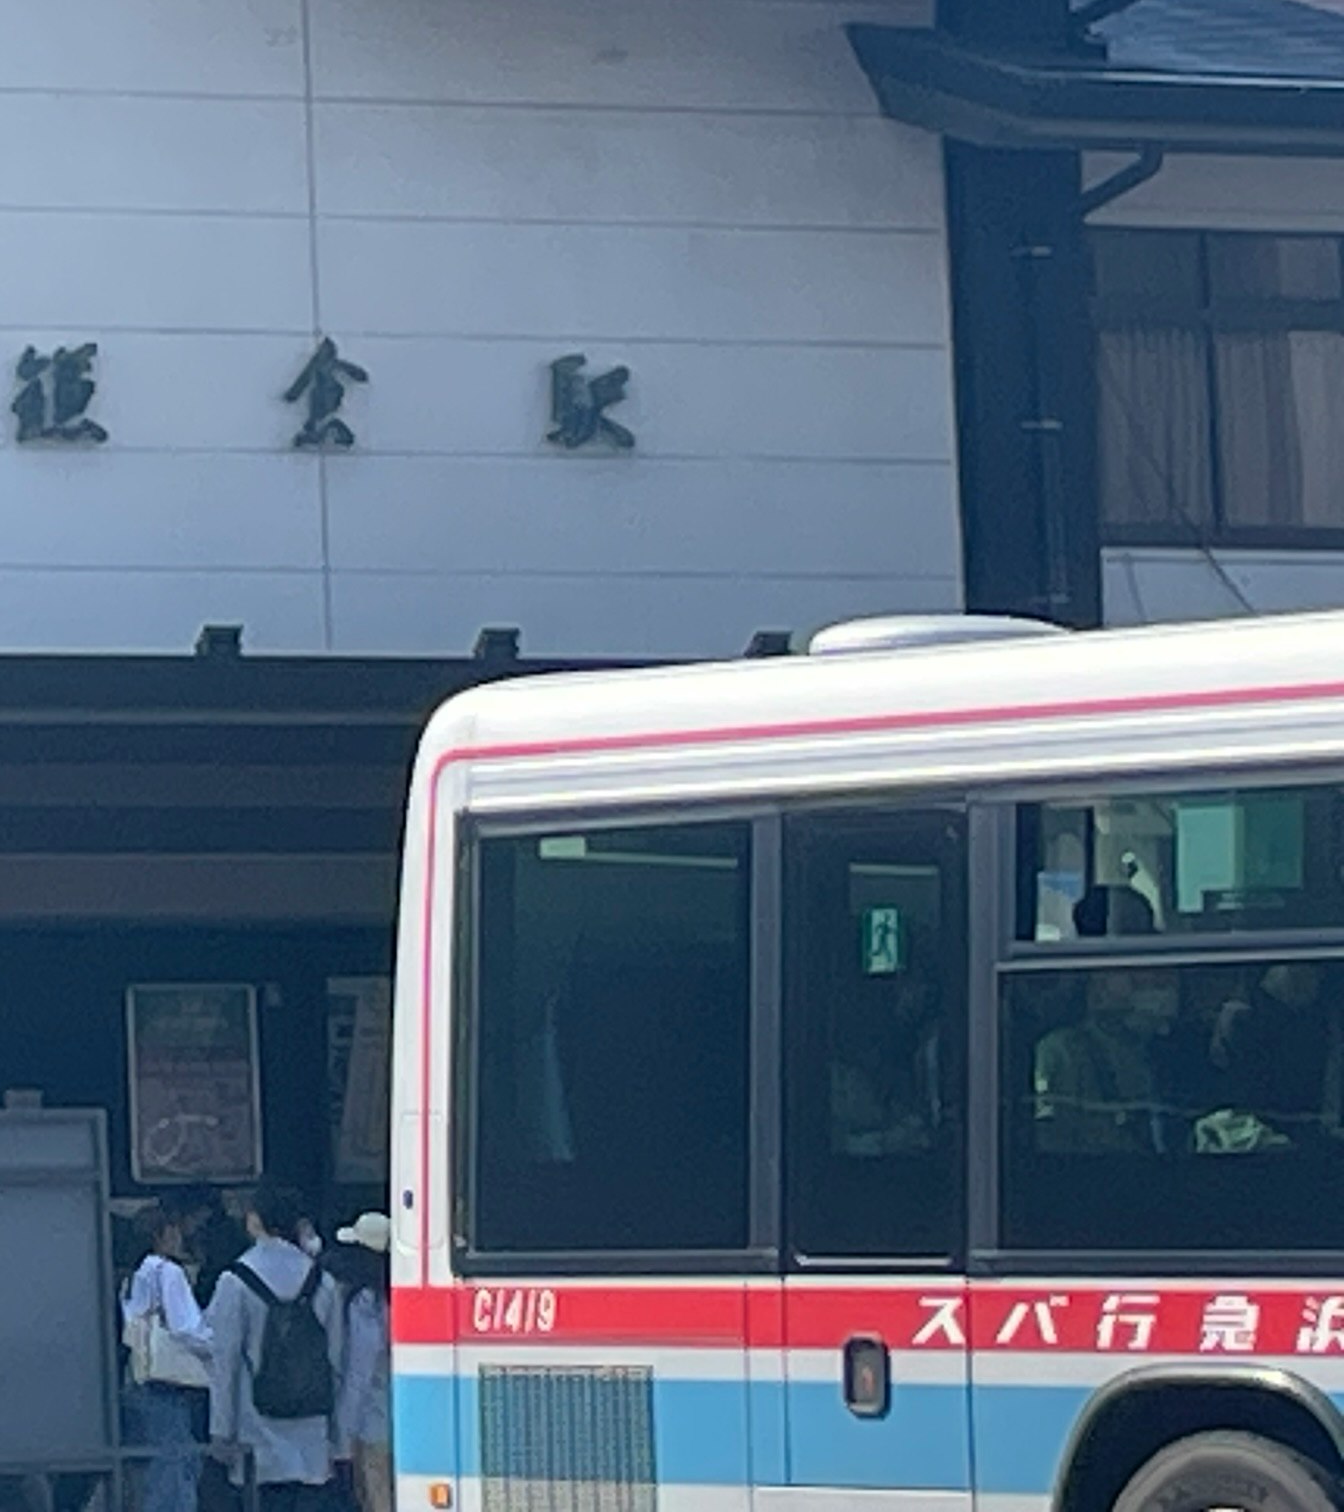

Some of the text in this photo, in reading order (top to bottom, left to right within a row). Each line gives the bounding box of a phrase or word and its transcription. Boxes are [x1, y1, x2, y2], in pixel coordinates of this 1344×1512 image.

[11, 337, 635, 448] 鎌倉駅
[473, 1288, 557, 1332] C1419
